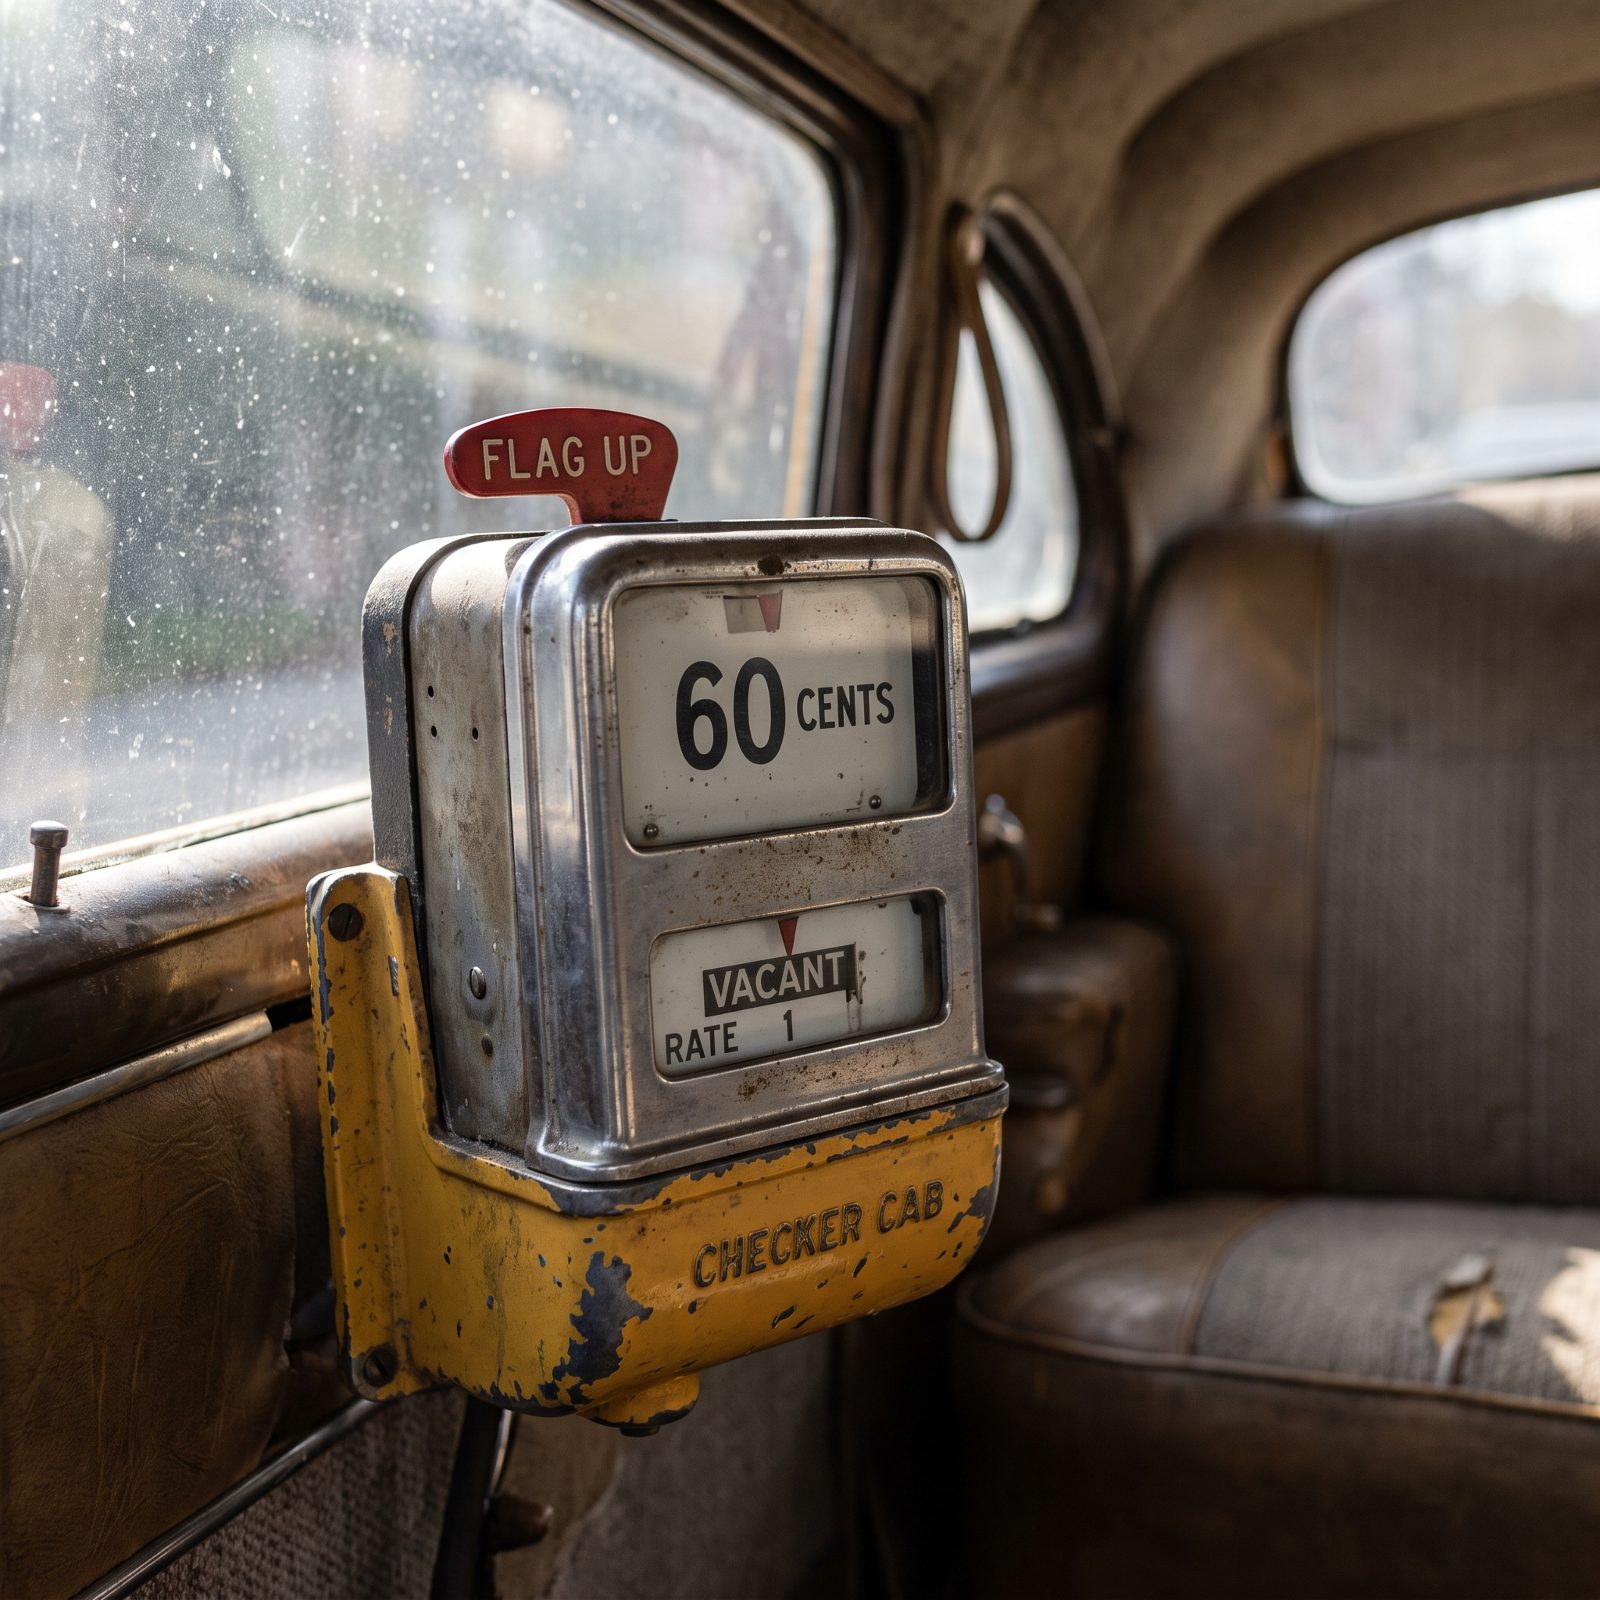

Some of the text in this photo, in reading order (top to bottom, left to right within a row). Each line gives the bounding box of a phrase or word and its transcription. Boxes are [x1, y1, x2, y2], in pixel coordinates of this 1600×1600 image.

[482, 434, 653, 480] FLAG UP
[676, 657, 896, 771] 60 CENTS
[708, 950, 846, 1009] VACANT
[665, 1009, 795, 1065] RATE 1
[694, 1179, 944, 1287] CHECKER CAB
